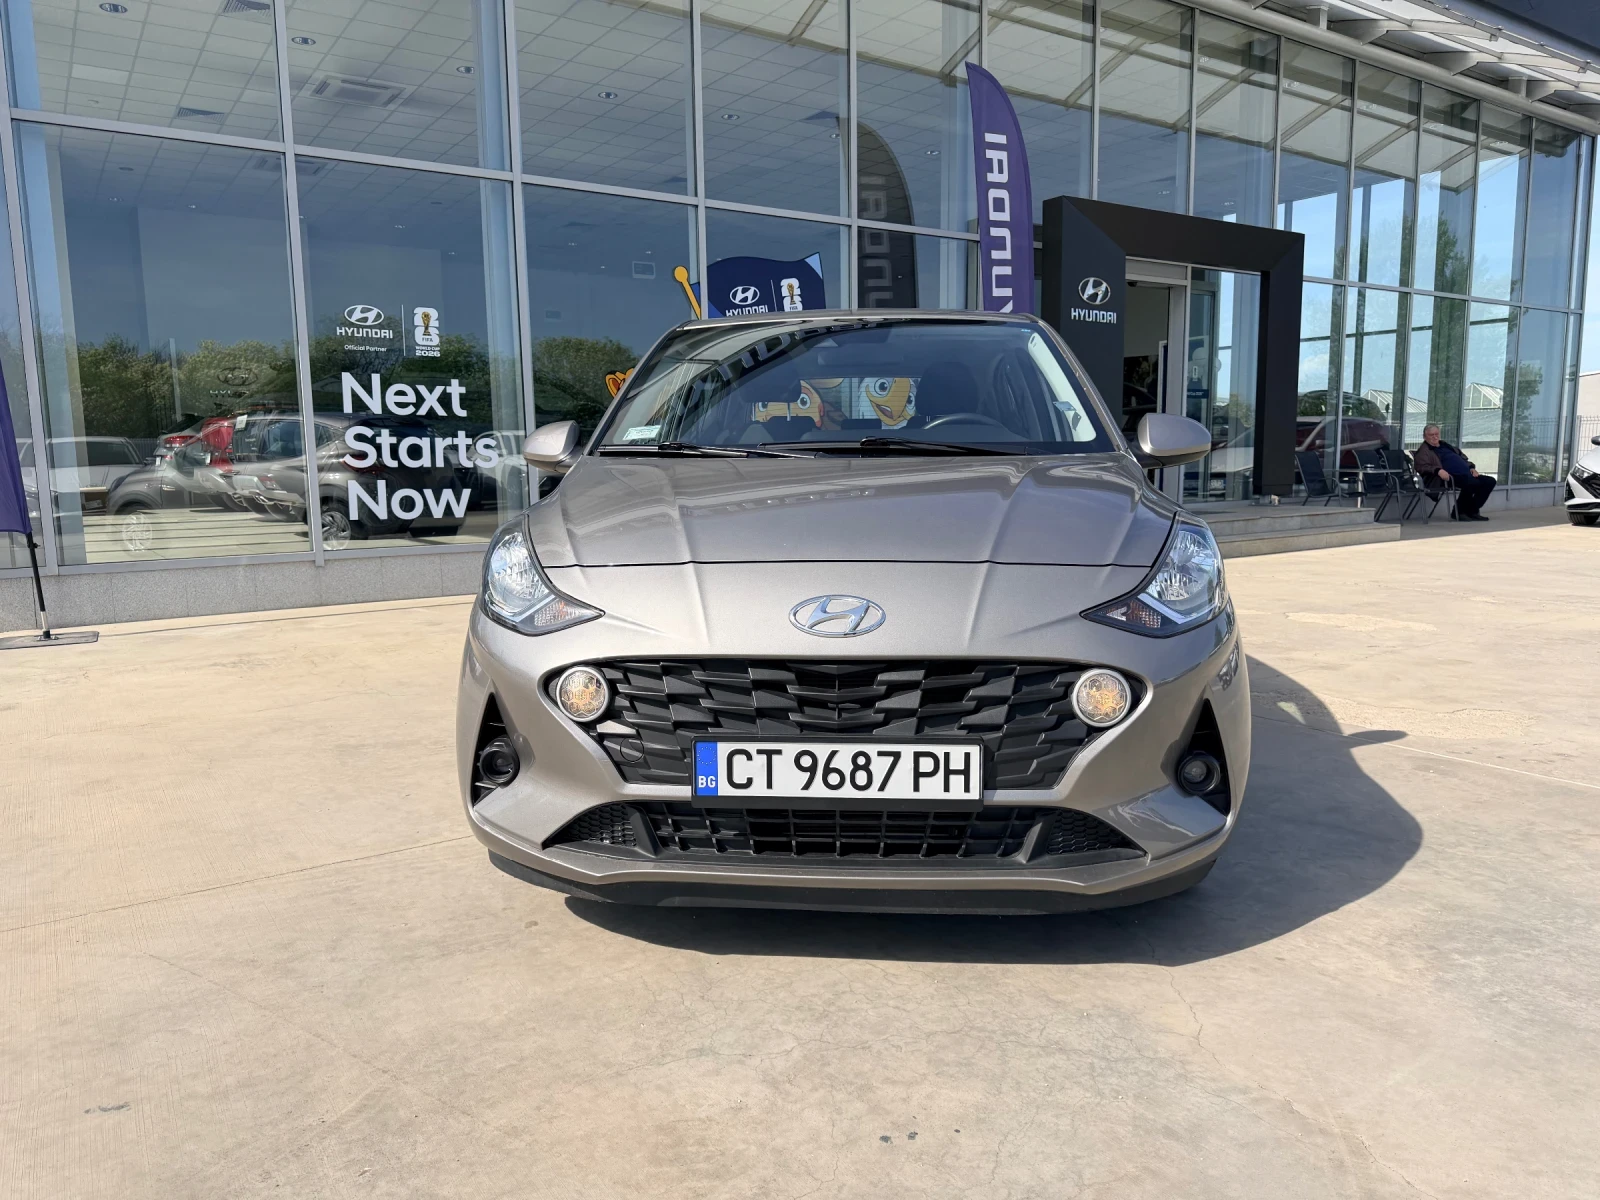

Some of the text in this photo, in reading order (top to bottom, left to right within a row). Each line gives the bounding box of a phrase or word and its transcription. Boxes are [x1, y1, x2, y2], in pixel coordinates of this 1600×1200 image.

[336, 326, 393, 339] HYUNDAI
[1071, 308, 1117, 324] HYUNDAI
[341, 372, 467, 417] Next
[343, 426, 499, 469] Starts
[347, 480, 471, 520] Now
[698, 776, 716, 788] BG
[726, 748, 971, 793] CT 9687 PH
